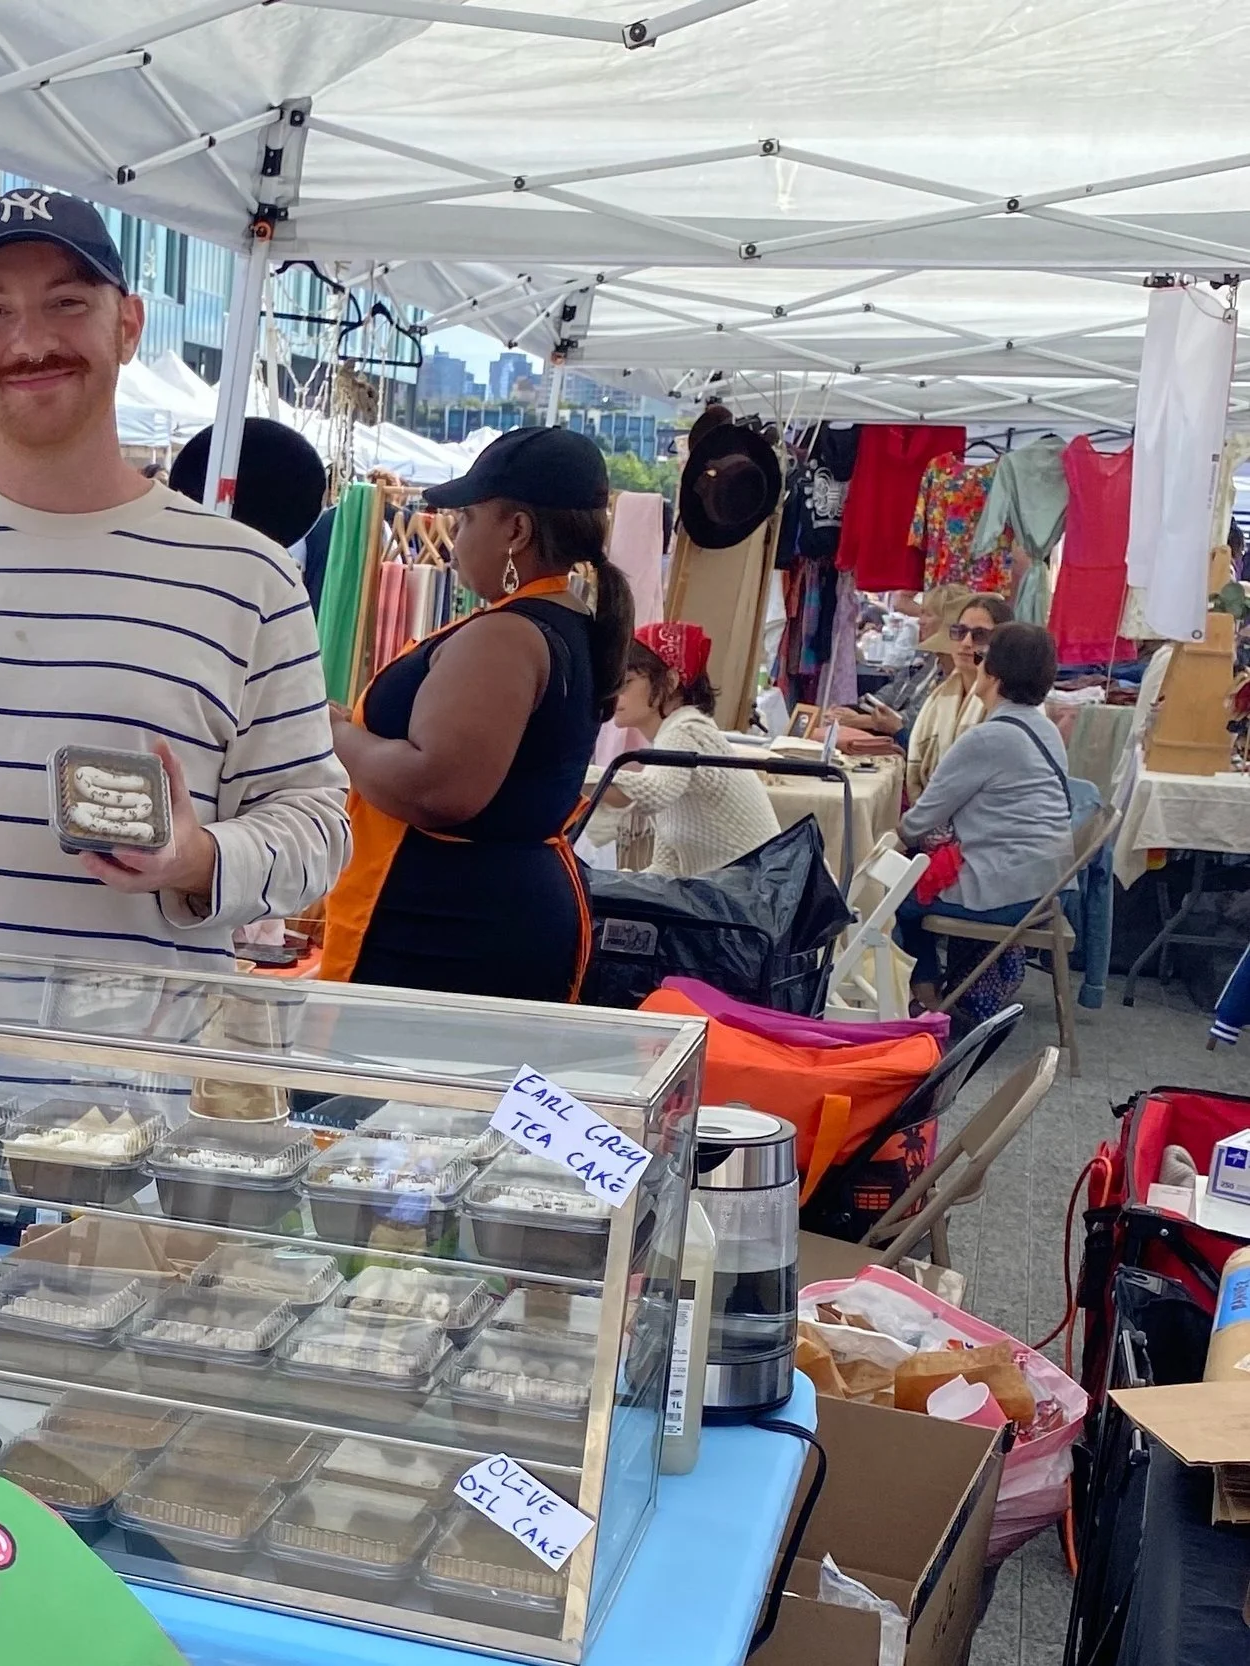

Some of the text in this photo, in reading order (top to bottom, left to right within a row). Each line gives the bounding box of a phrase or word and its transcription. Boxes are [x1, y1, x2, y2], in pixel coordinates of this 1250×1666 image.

[0, 191, 53, 223] NY
[510, 1111, 626, 1193] TEA CAKE
[513, 1074, 647, 1174] EARL GREY
[460, 1475, 568, 1560] OIL CAKE
[488, 1458, 559, 1515] OLIVE
